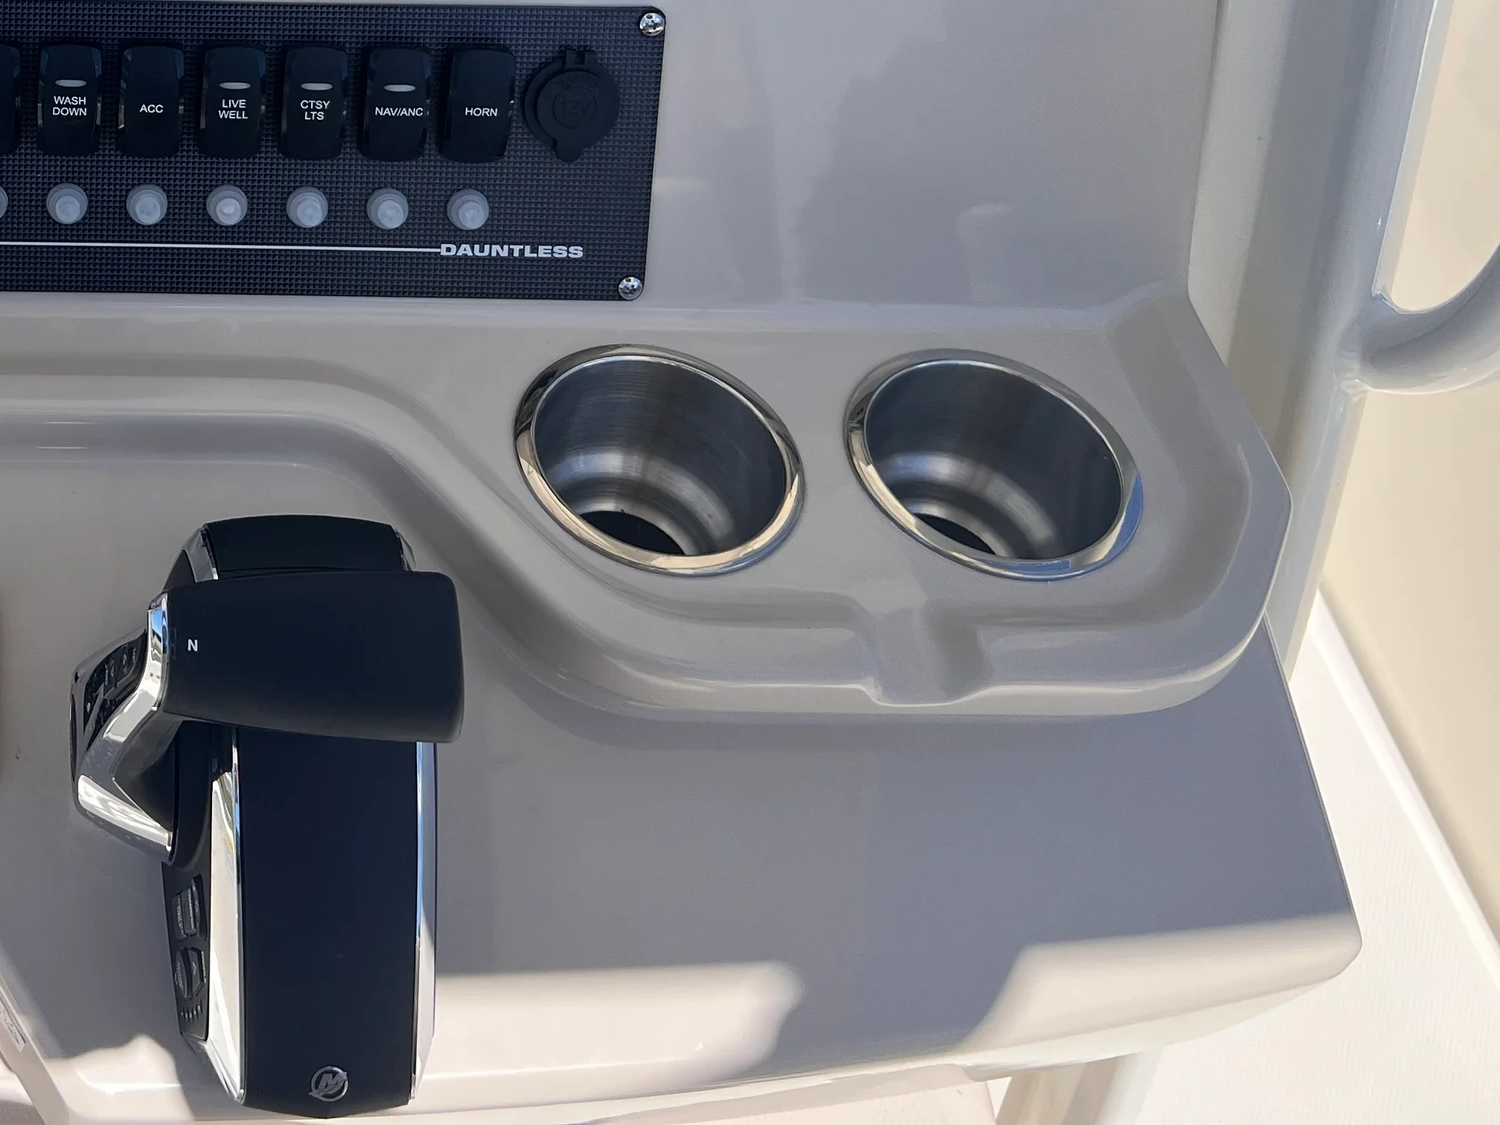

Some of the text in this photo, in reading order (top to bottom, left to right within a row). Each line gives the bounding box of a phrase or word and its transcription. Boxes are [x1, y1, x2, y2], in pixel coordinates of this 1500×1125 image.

[53, 95, 87, 106] WASH
[221, 98, 247, 109] LIVE
[300, 99, 330, 110] CTSY
[52, 106, 87, 117] DOWN
[139, 104, 164, 114] ACC
[218, 109, 248, 120] WELL
[375, 106, 424, 117] NAV/ANC
[464, 106, 498, 117] HORN
[304, 110, 324, 121] LTS
[440, 243, 584, 258] DAUNTLESS
[187, 638, 198, 652] N
